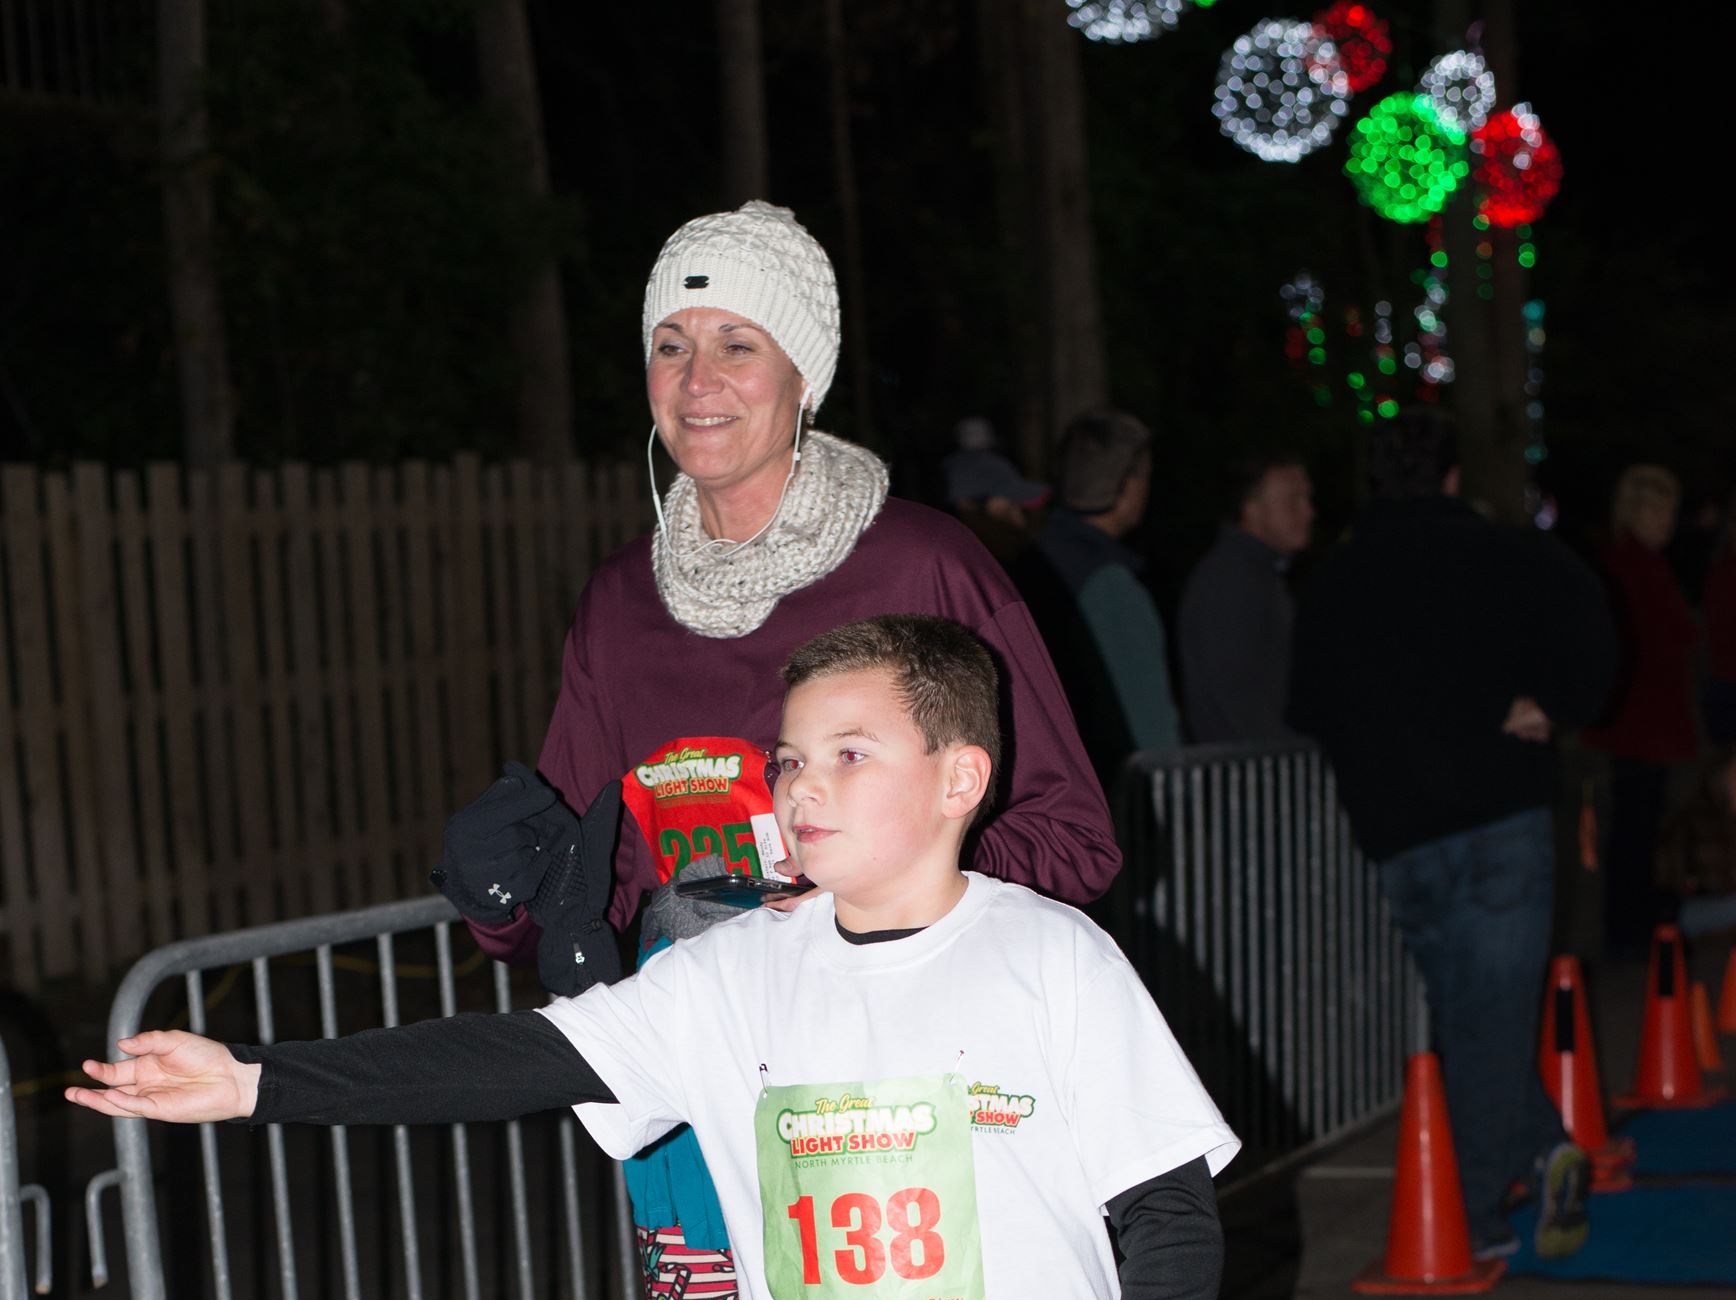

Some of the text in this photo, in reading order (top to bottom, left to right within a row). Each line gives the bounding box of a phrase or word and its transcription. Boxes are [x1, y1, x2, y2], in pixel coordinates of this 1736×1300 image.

[664, 746, 706, 765] The Great
[636, 755, 741, 787] CHRISTMAS
[656, 776, 727, 798] LIGHT SHOW
[816, 1093, 873, 1114] The Great
[778, 1102, 936, 1142] CHRISTMAS
[976, 1111, 1019, 1126] SHOW
[792, 1132, 915, 1156] LIGHT SHOW
[794, 1154, 913, 1169] NORTH MYRTLE BEACH
[788, 1187, 945, 1285] 138
